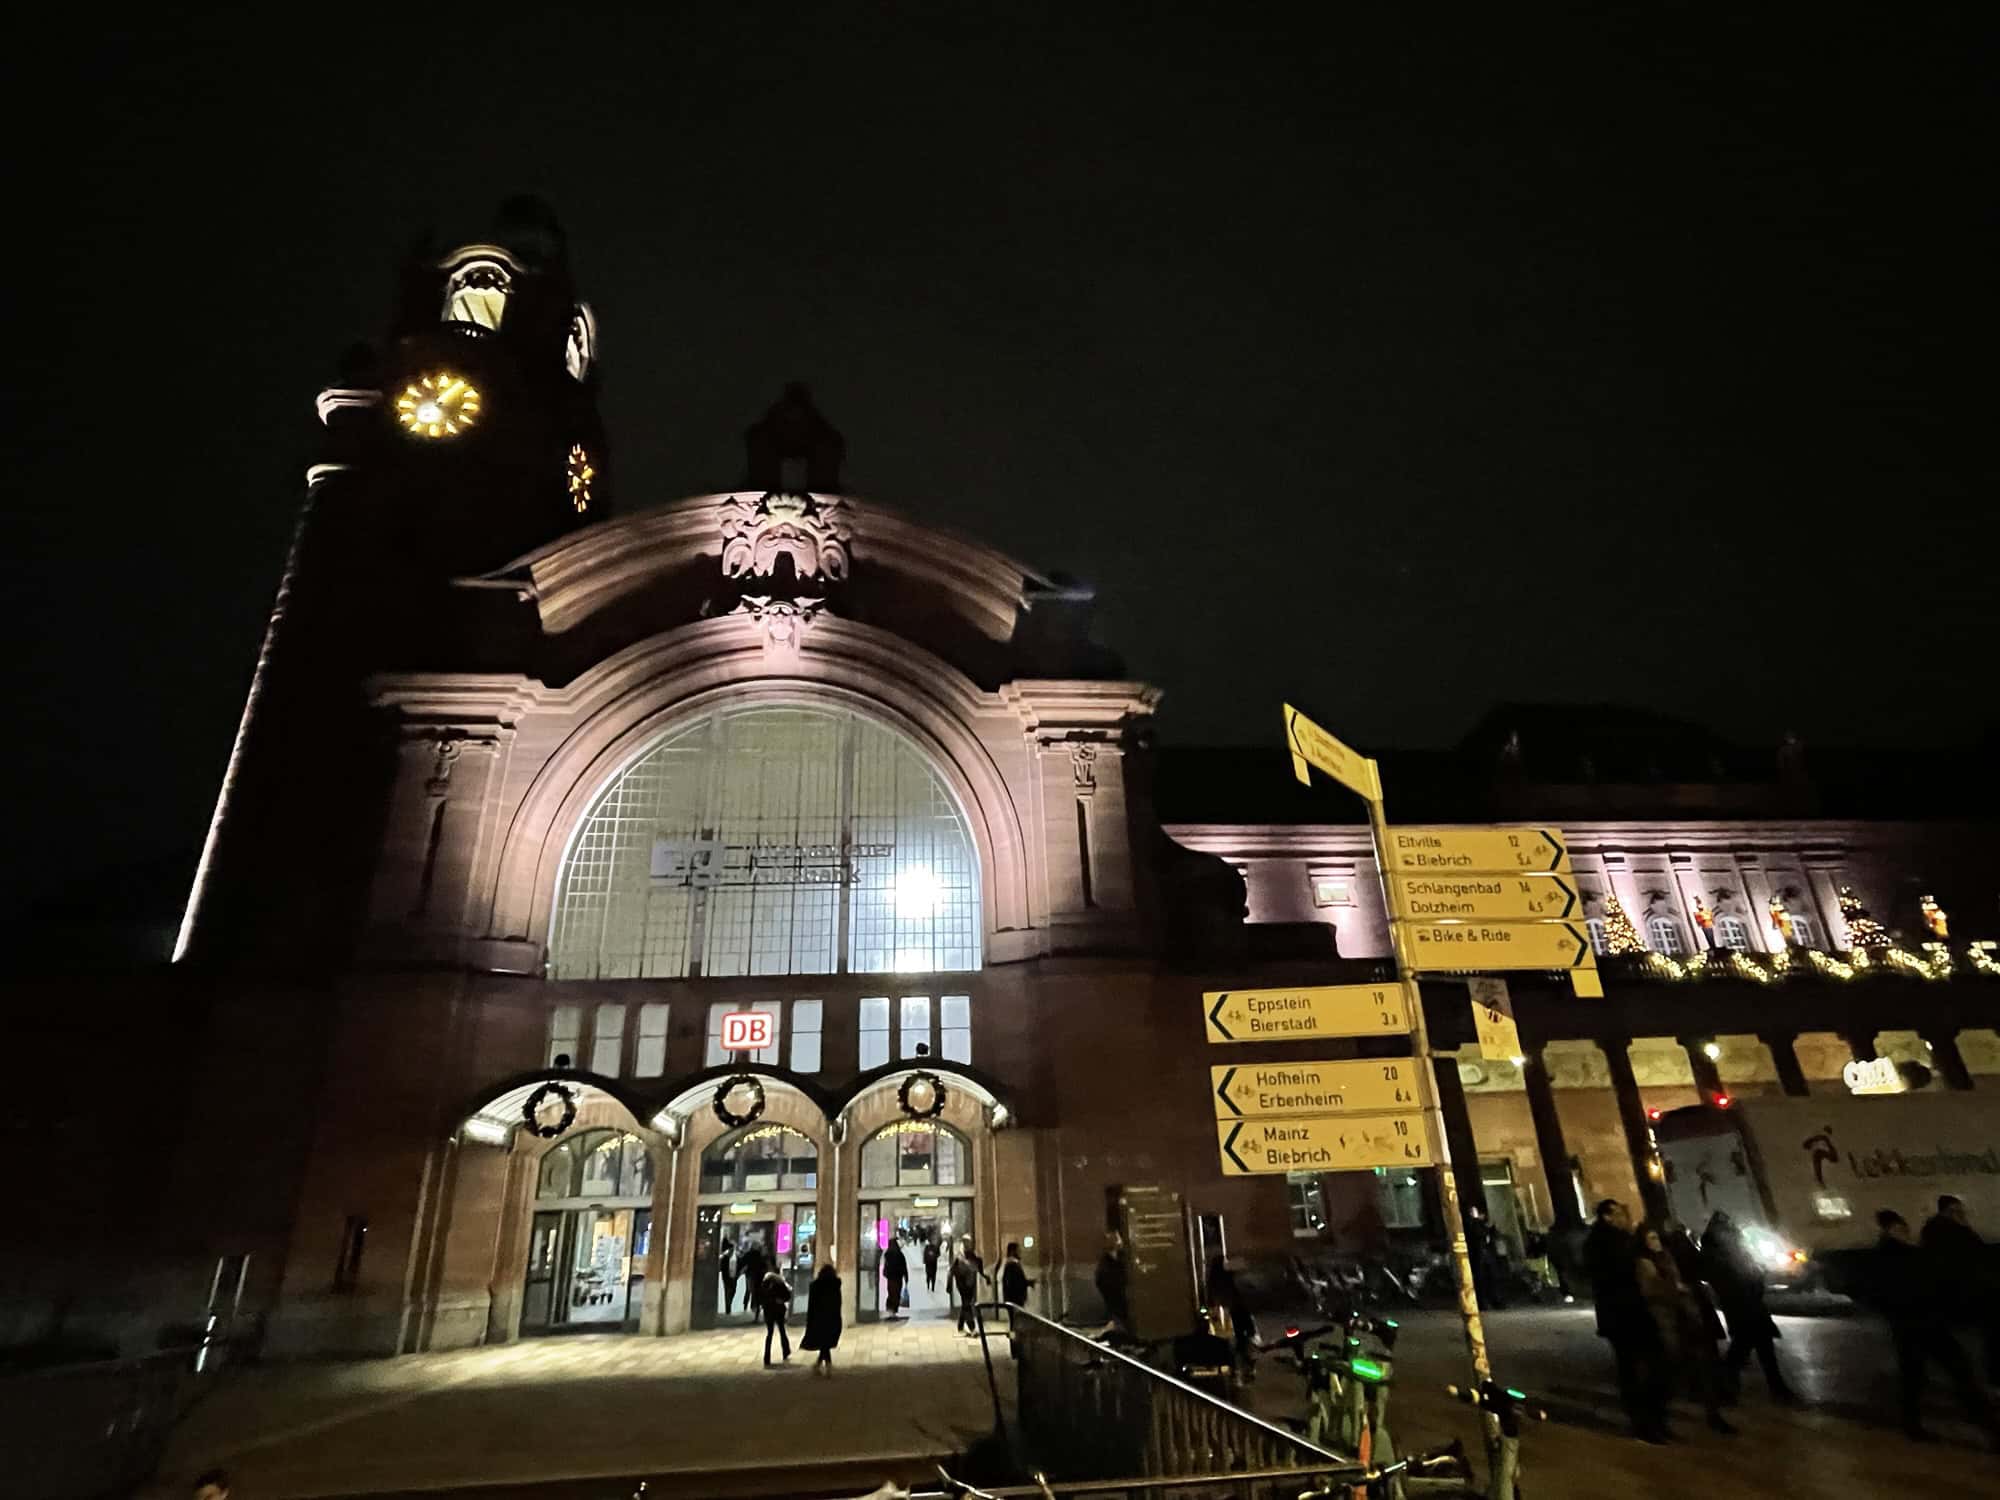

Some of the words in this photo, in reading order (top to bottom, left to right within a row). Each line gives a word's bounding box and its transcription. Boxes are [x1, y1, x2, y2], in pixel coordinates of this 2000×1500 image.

[1417, 853, 1472, 866] Biebrich
[1407, 882, 1501, 897] Schlangenbad
[1518, 881, 1531, 893] 14
[1411, 901, 1475, 913] Dotzheim
[1433, 928, 1463, 942] Bike
[1467, 929, 1478, 941] &
[1481, 929, 1511, 941] Ride
[1248, 997, 1311, 1014] Eppstein
[1373, 992, 1384, 1005] 19
[730, 1019, 766, 1042] DB
[1251, 1016, 1317, 1032] Bierstadt
[1257, 1070, 1320, 1087] Hofheim
[1384, 1066, 1398, 1081] 20
[1260, 1092, 1343, 1108] Erbenheim
[1264, 1127, 1310, 1141] Mainz
[1395, 1120, 1408, 1136] 10
[1267, 1147, 1331, 1164] Biebrich
